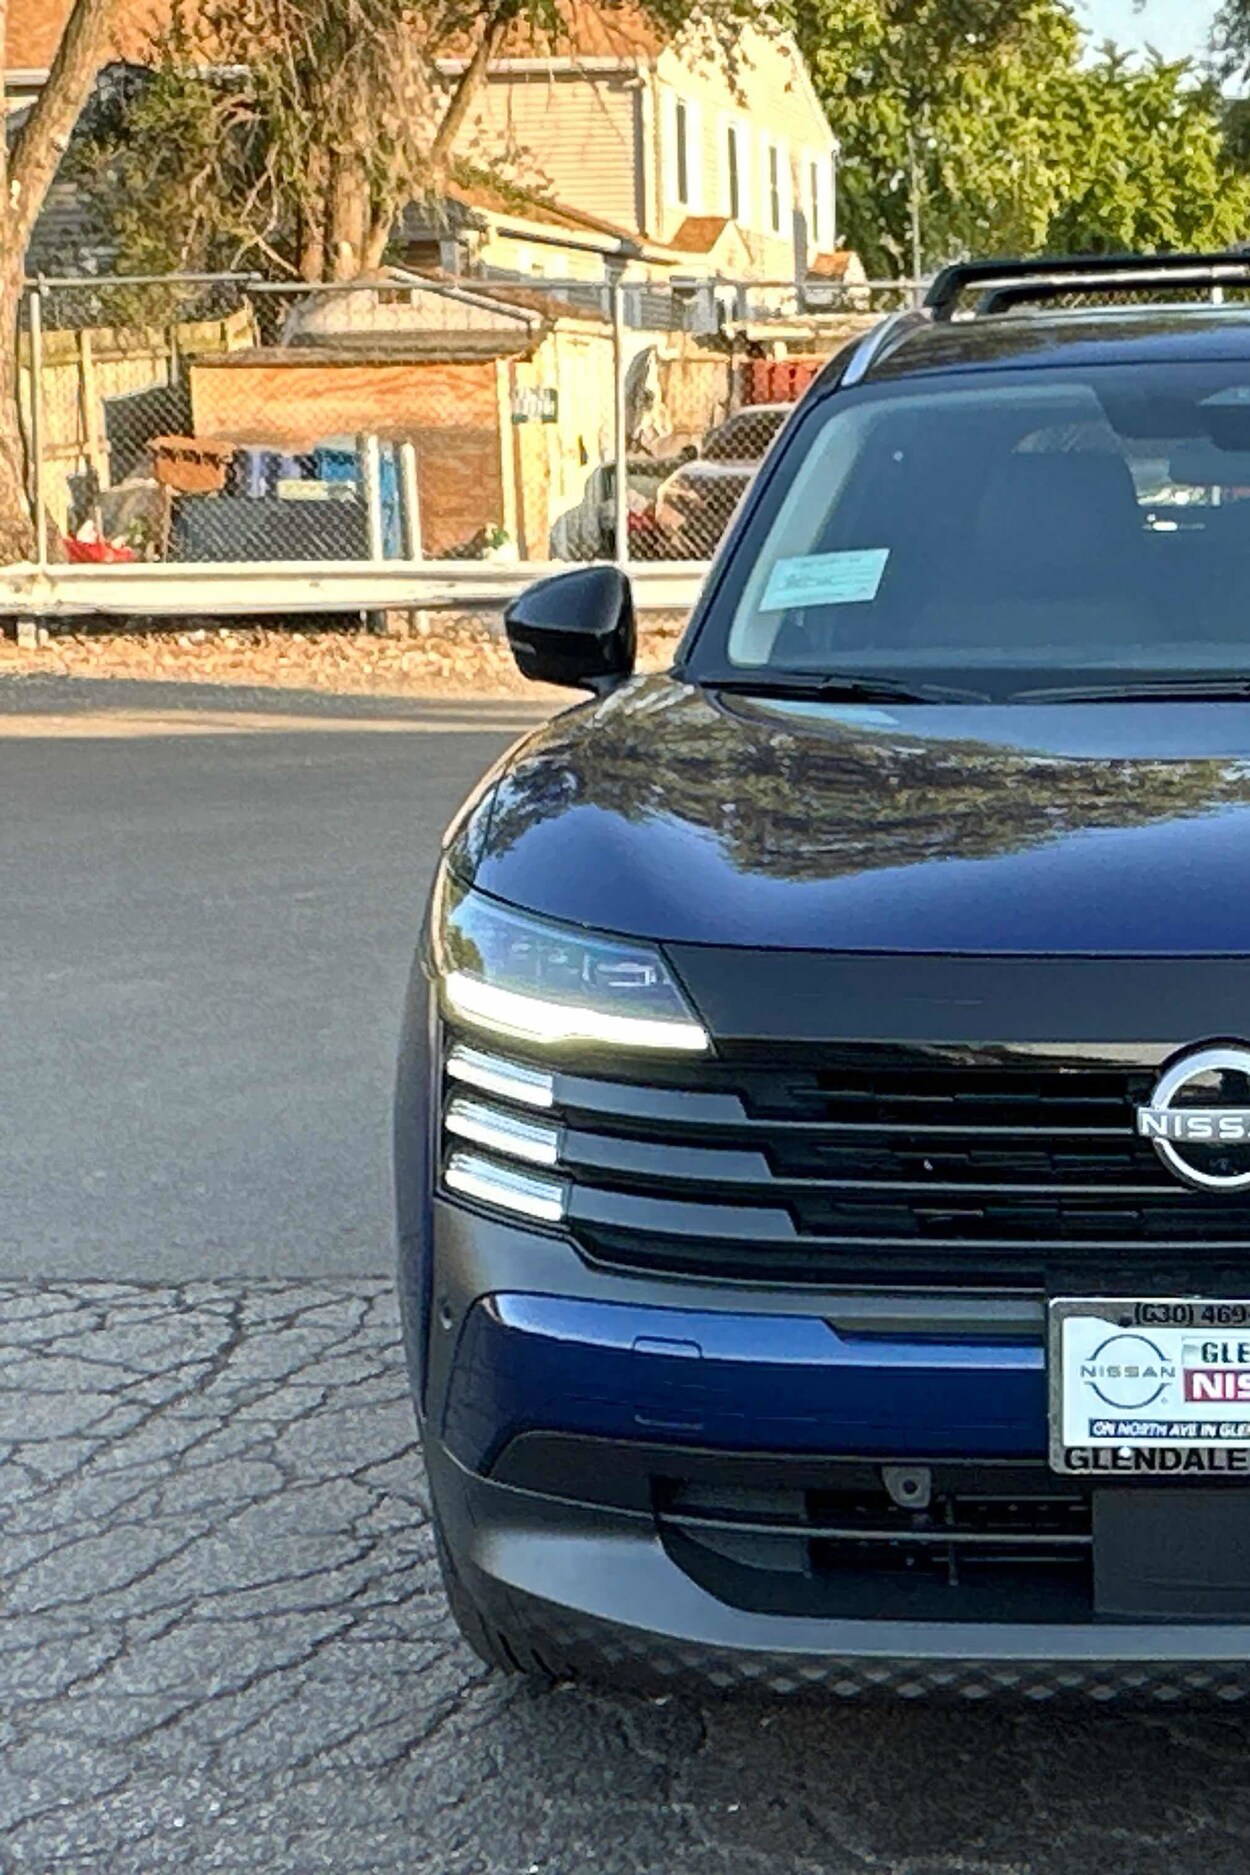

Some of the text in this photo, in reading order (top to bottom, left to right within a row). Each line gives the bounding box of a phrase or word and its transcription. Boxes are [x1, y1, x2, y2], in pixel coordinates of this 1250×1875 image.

[1134, 1303, 1194, 1326] (630)
[1080, 1365, 1176, 1379] NISSAN
[1092, 1421, 1115, 1437] ON
[1117, 1422, 1168, 1438] NORTH
[1200, 1423, 1217, 1438] IN
[1063, 1447, 1249, 1472] GLENDALE
